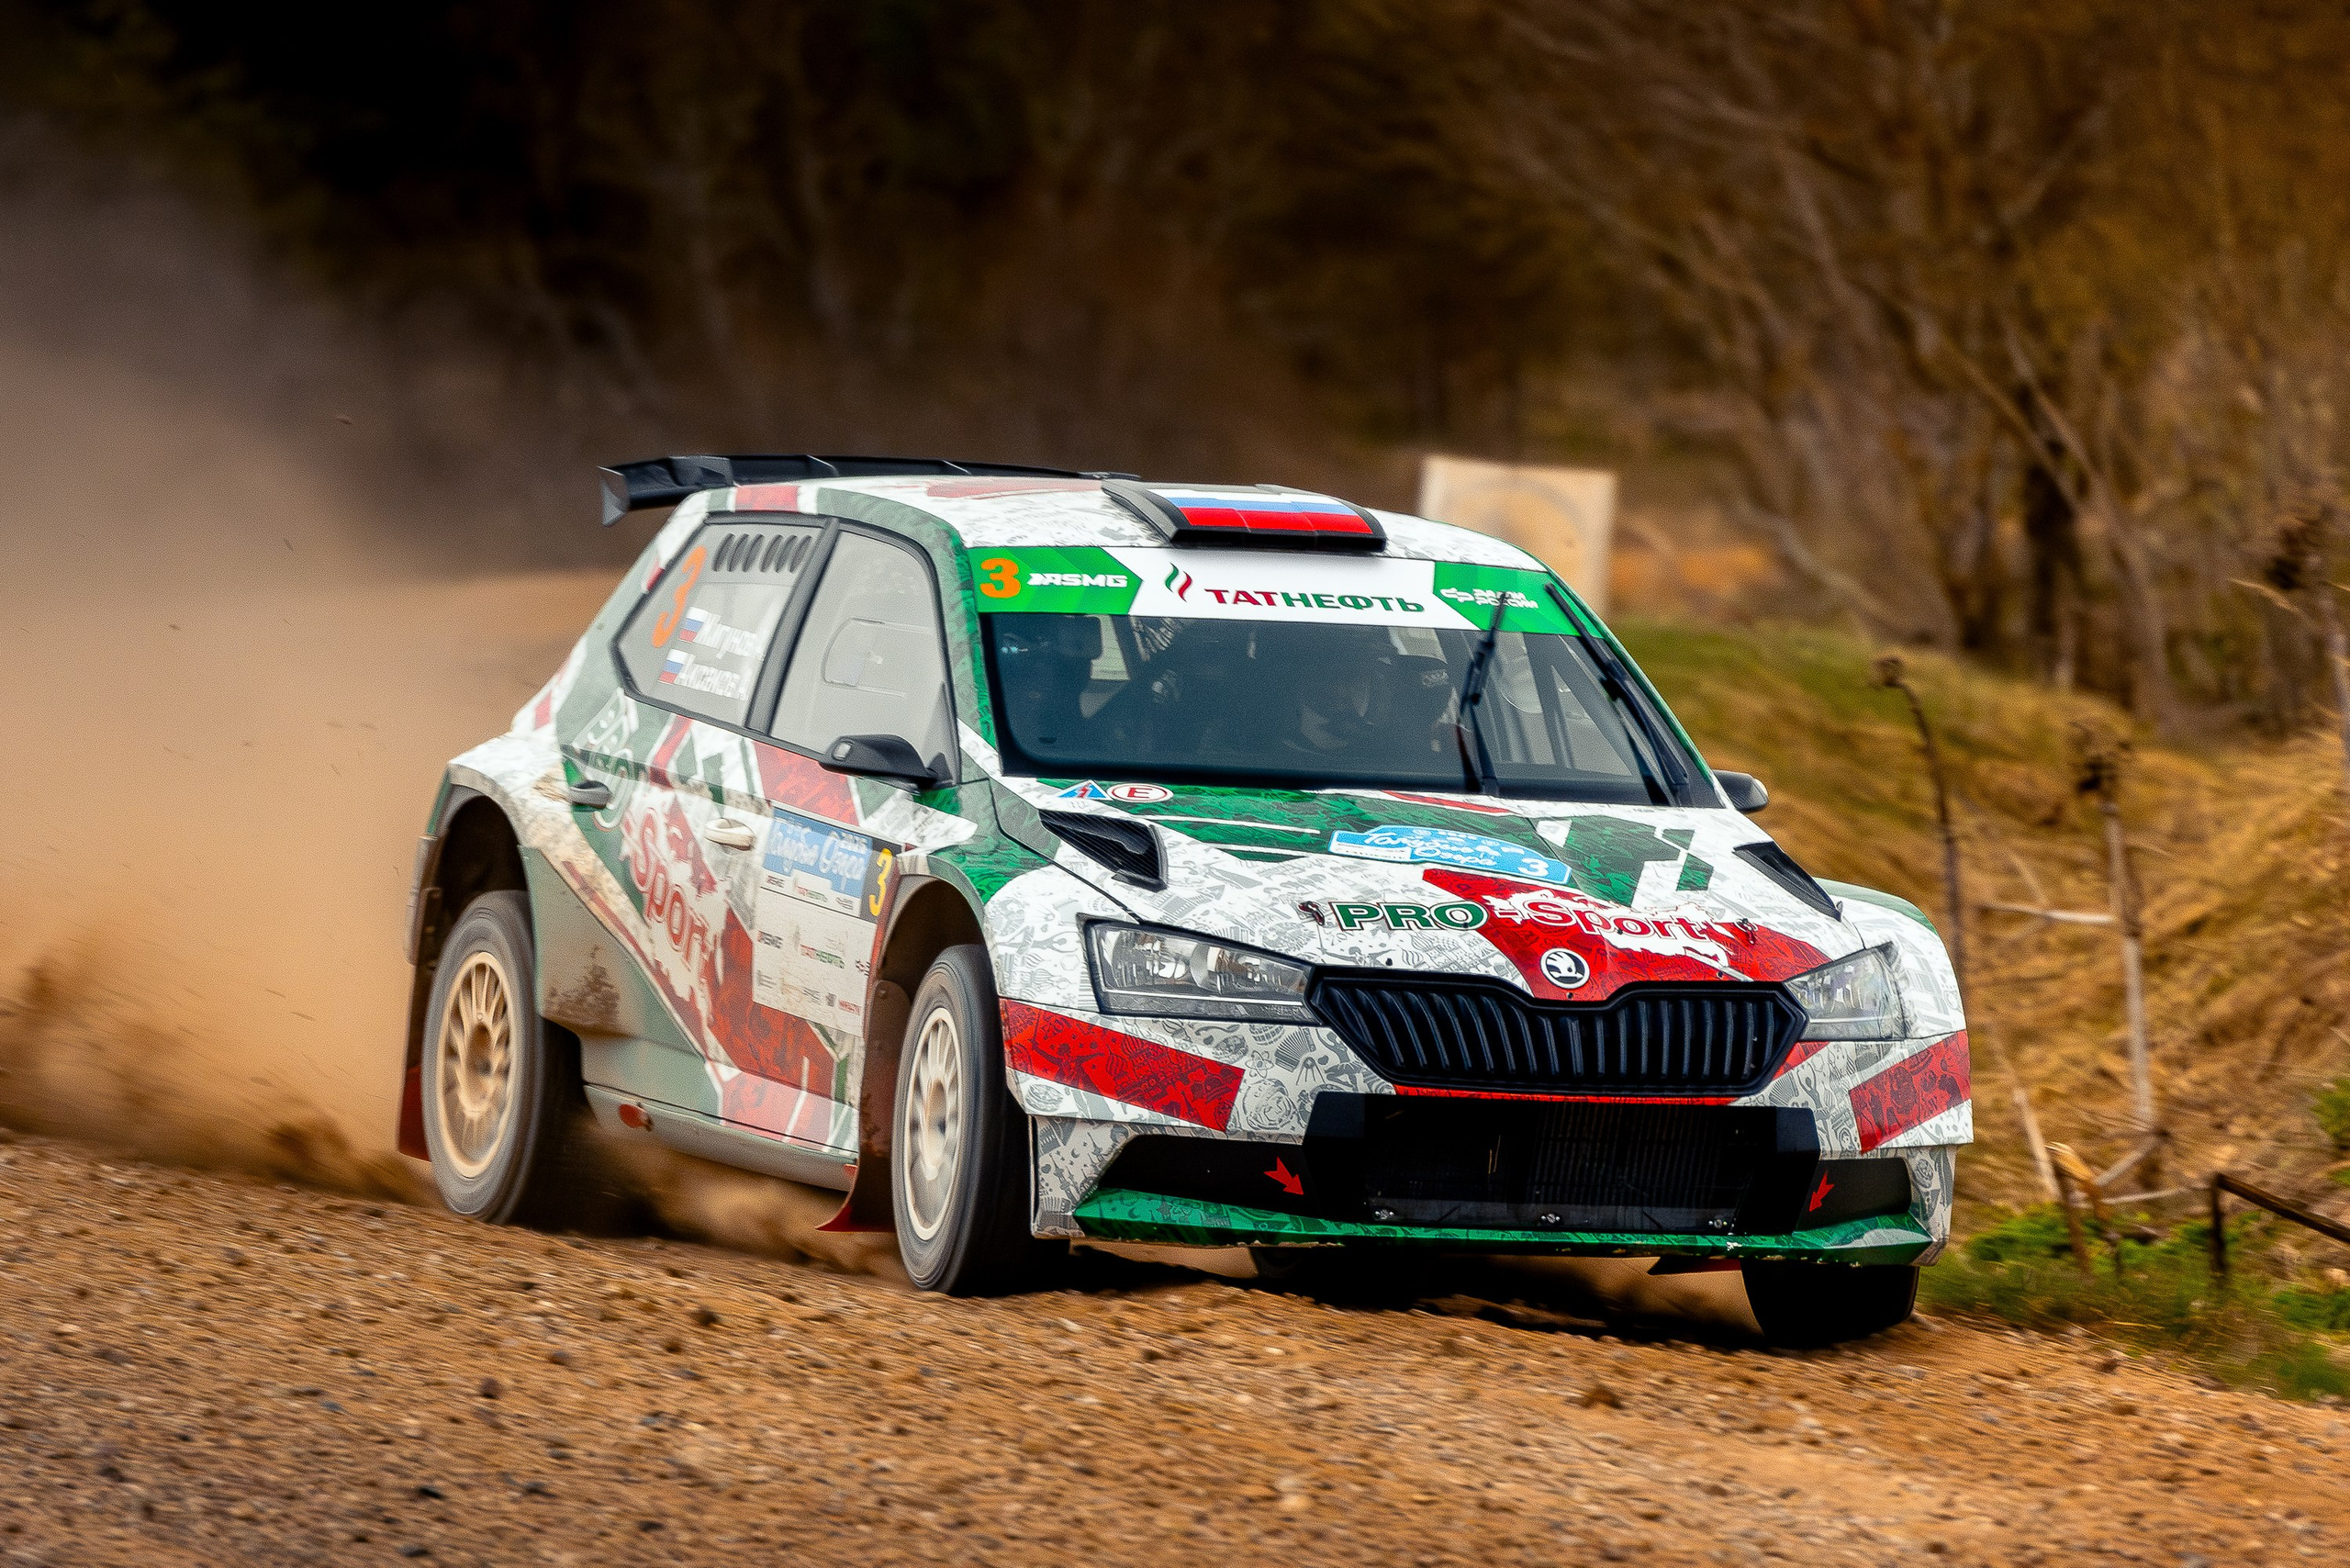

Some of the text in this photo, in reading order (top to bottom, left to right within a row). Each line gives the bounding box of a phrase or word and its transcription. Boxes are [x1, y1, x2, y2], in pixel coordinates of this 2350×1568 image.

[651, 544, 708, 649] 3
[979, 557, 1022, 599] 3
[1203, 588, 1426, 613] ТАТНЕФТЬ
[868, 847, 893, 916] 3
[1517, 857, 1550, 877] 3
